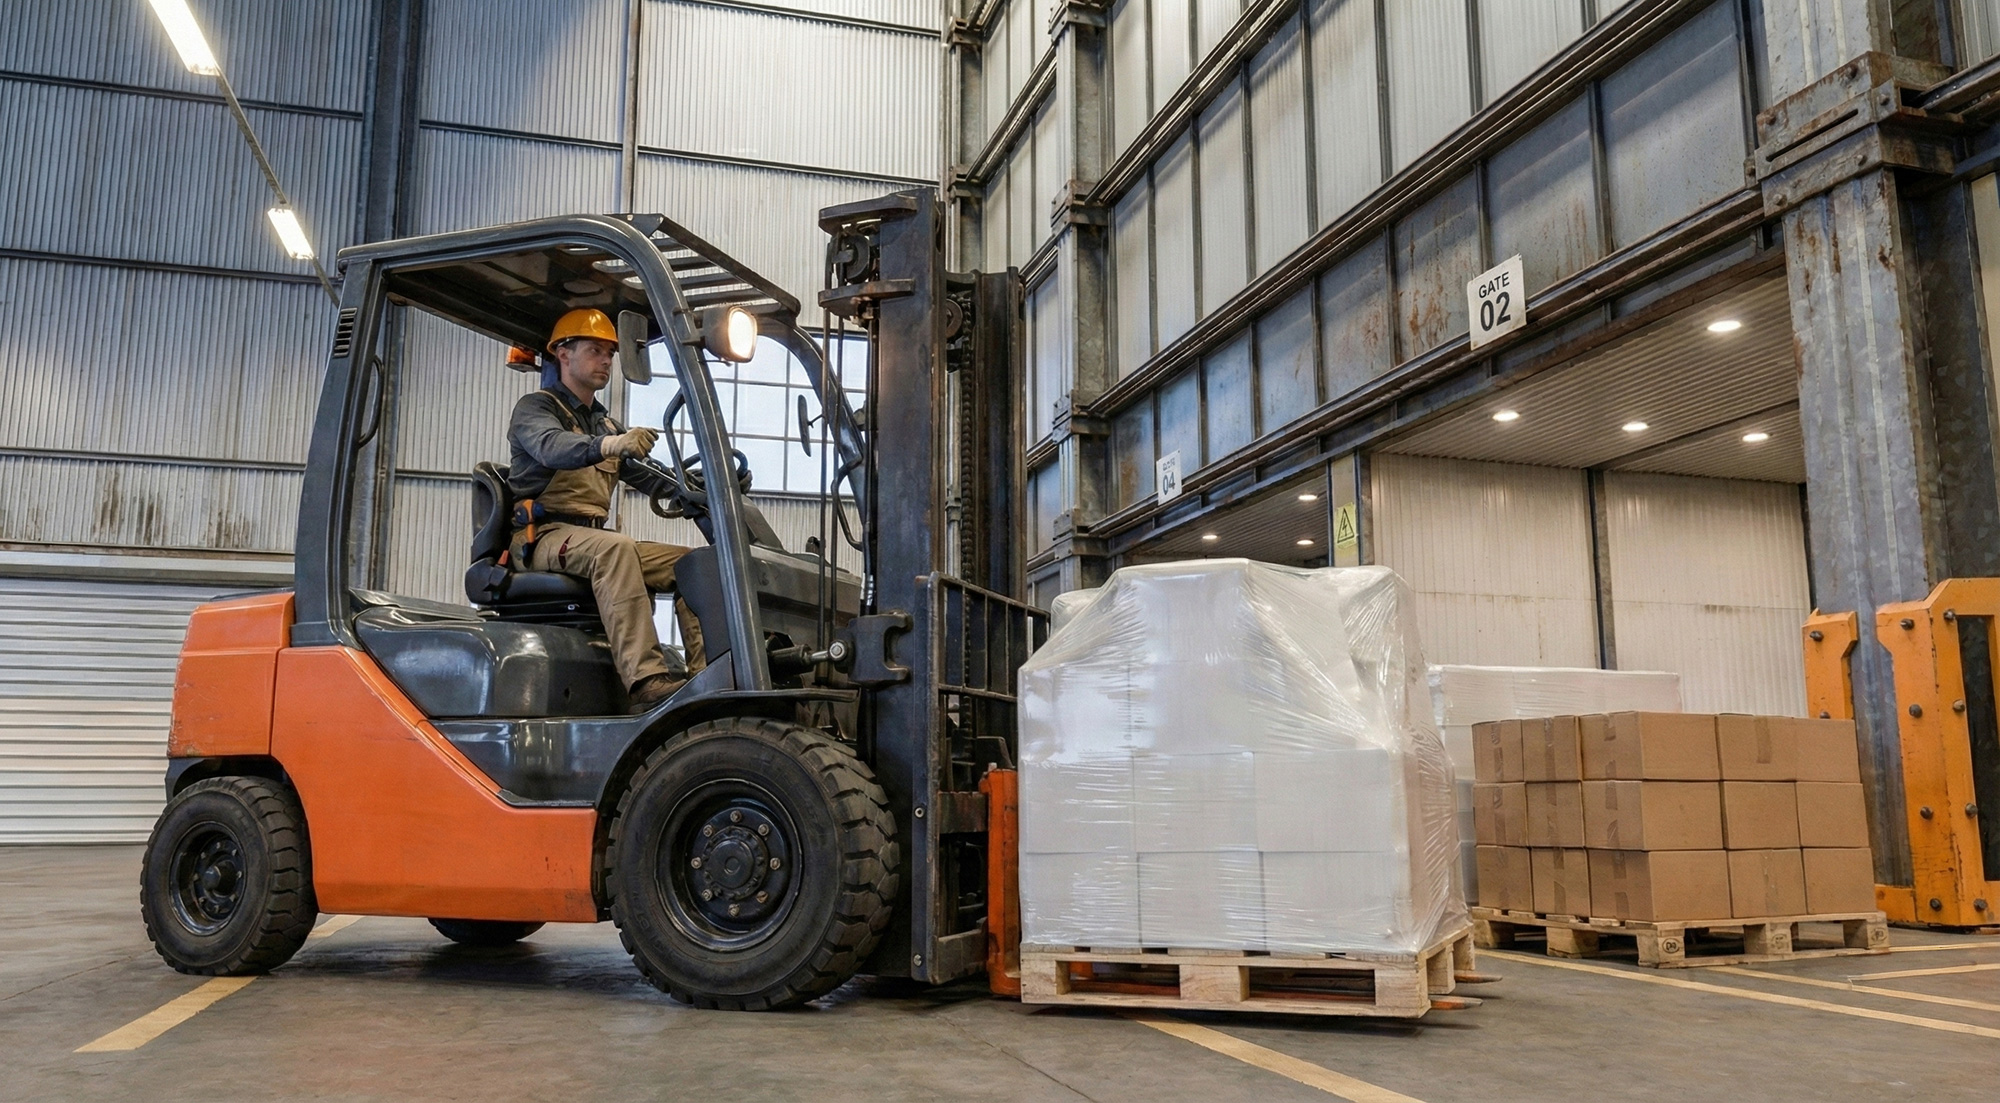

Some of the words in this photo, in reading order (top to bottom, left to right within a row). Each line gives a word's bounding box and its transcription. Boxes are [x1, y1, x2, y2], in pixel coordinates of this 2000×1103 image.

[1478, 271, 1510, 299] GATE
[1480, 291, 1511, 332] 02
[1162, 471, 1176, 496] 04
